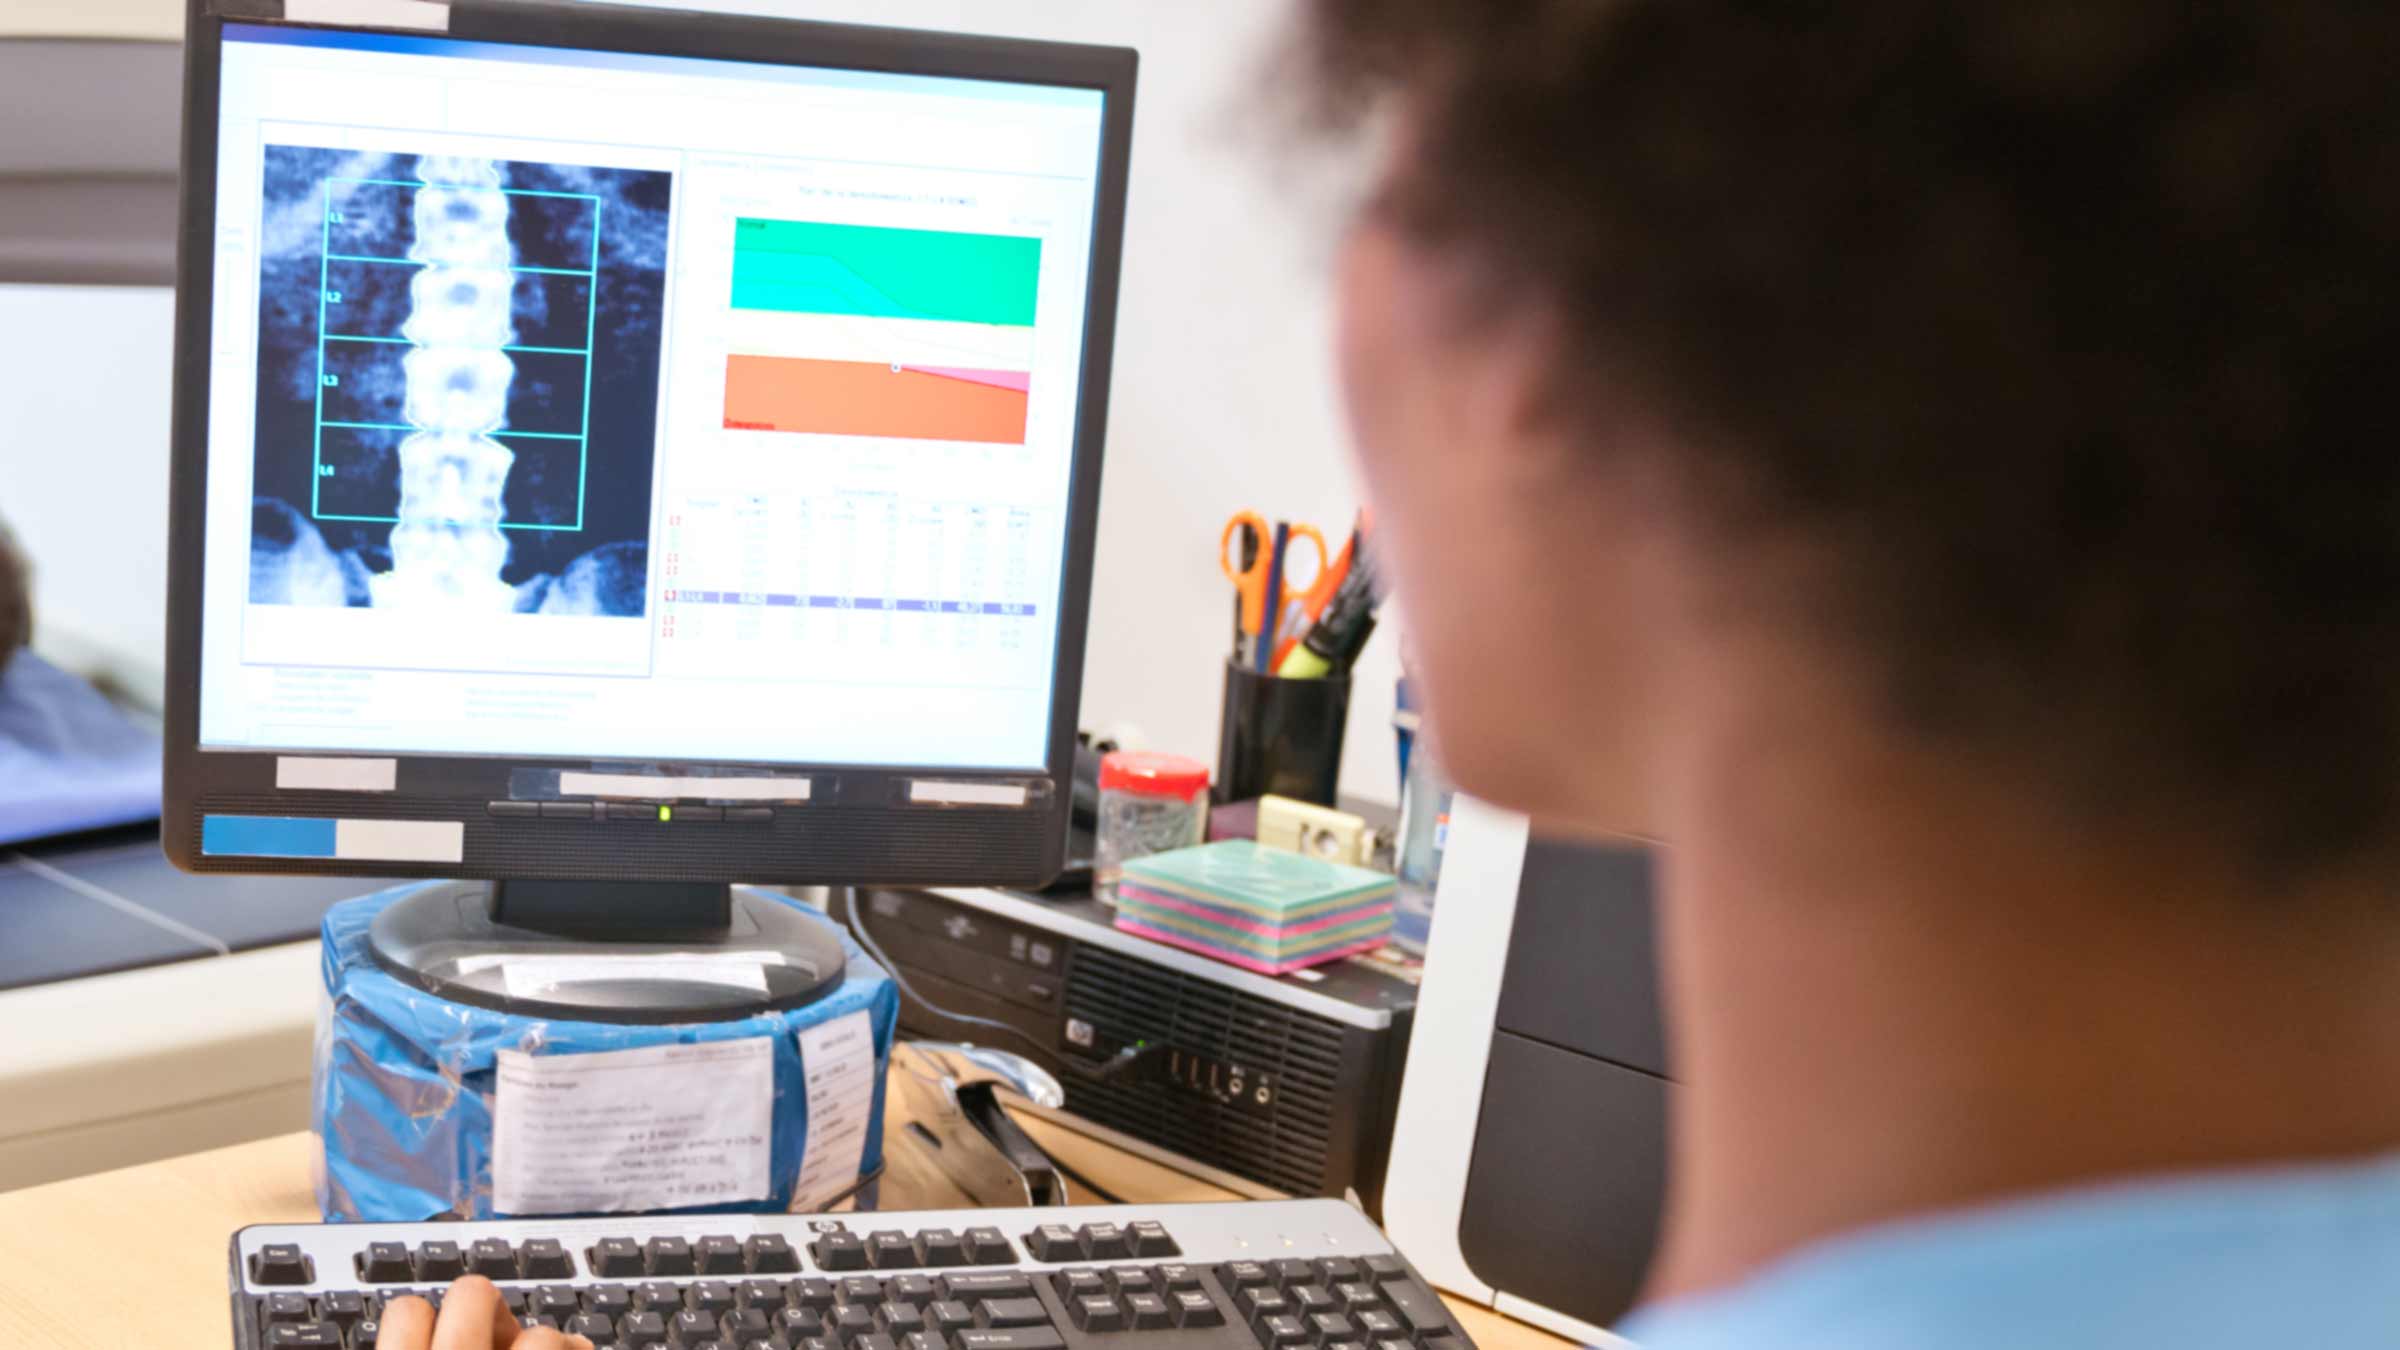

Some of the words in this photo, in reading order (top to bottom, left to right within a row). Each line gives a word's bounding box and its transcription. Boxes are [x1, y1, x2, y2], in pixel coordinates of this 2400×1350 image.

[326, 291, 342, 303] L2
[322, 374, 339, 387] L3
[319, 464, 335, 476] L4
[361, 1322, 377, 1331] Q
[682, 1313, 696, 1323] U
[788, 1308, 802, 1319] O
